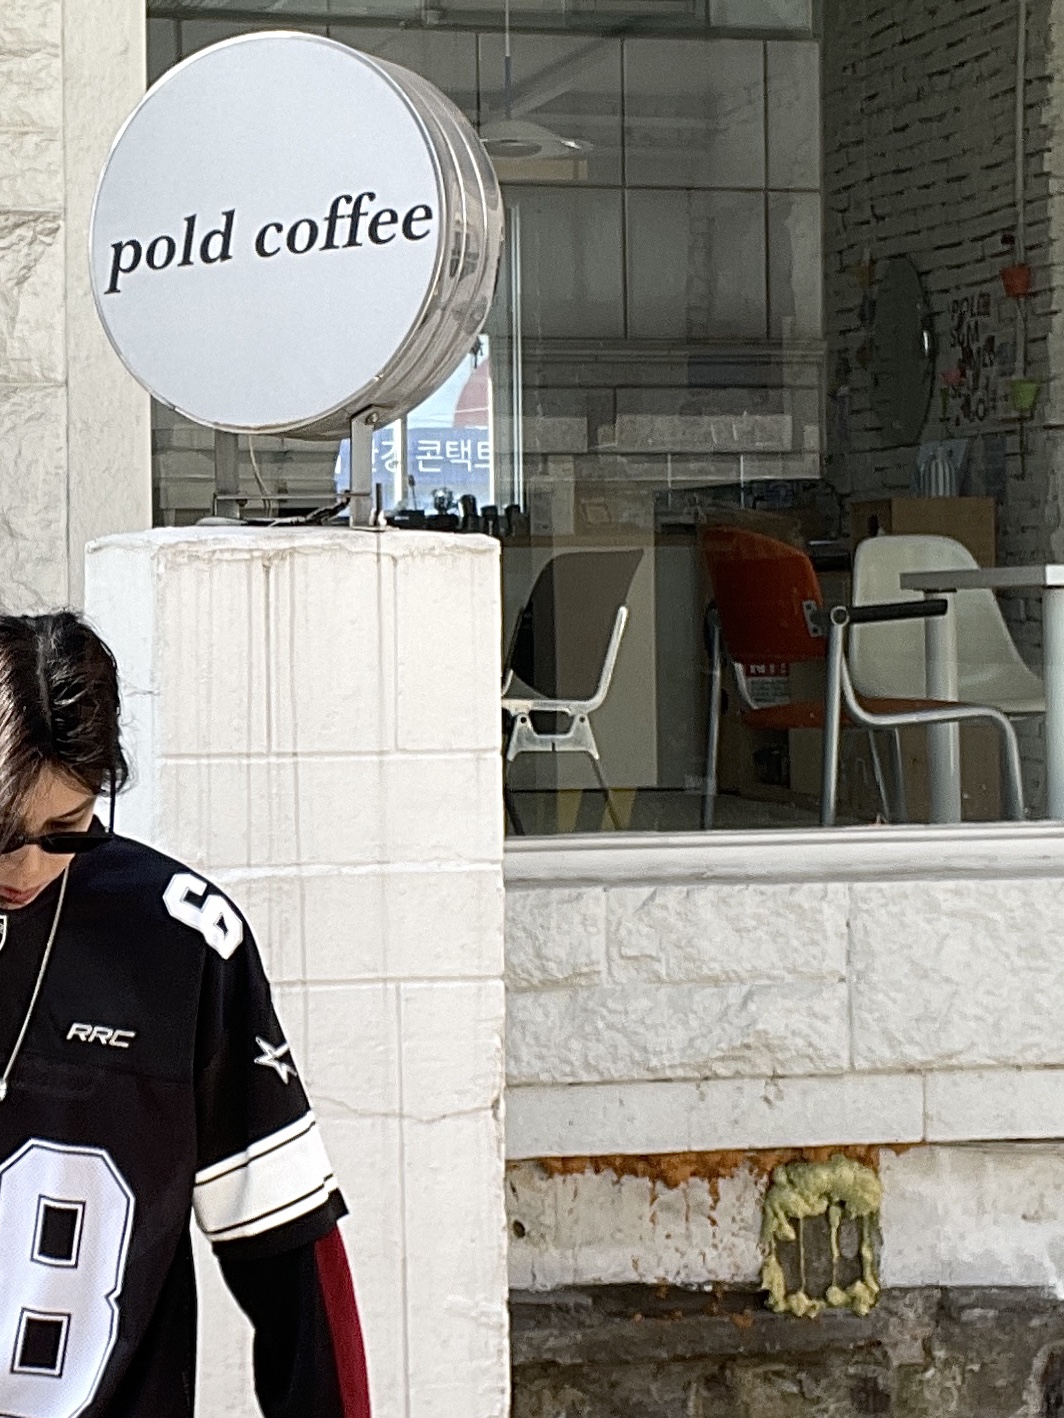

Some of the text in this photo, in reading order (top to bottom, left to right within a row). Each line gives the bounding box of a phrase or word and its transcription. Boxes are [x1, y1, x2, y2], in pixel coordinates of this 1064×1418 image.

[104, 191, 433, 294] pold coffee
[162, 872, 244, 960] 6
[66, 1022, 135, 1048] RRC
